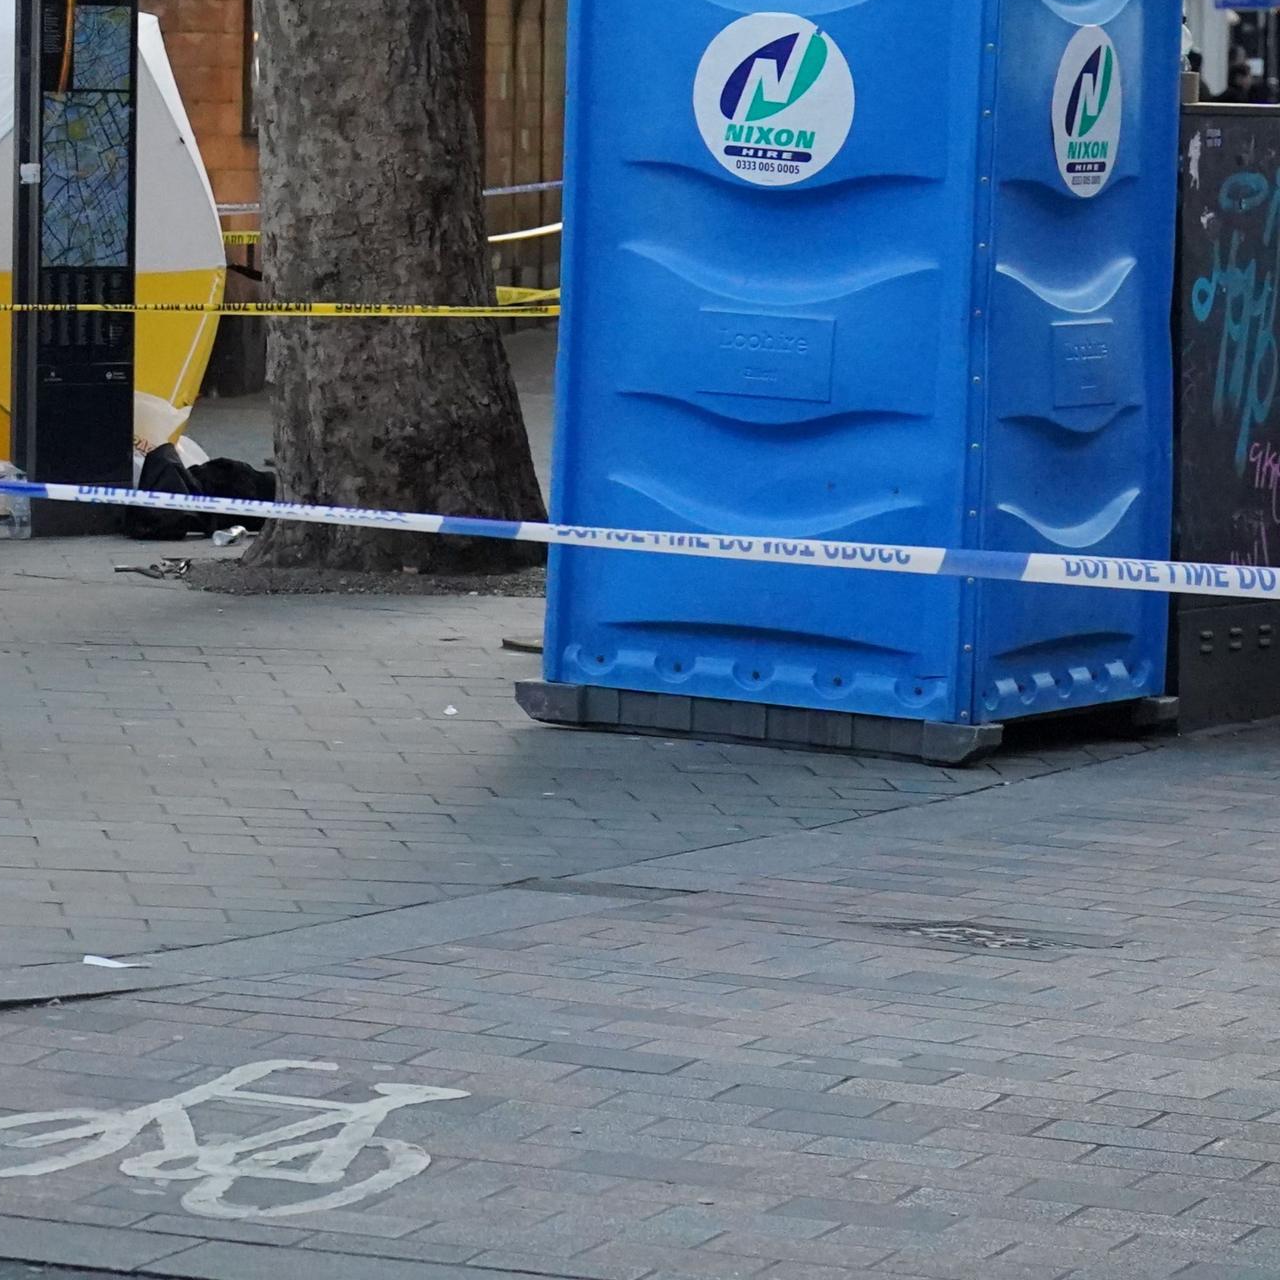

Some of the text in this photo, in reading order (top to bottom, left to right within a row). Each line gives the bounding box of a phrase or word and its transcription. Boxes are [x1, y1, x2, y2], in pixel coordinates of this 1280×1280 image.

[724, 124, 816, 149] NIXON
[742, 148, 793, 160] HIRE
[1067, 141, 1109, 160] NIXON
[736, 159, 800, 175] 0333 005 0005
[1075, 162, 1099, 172] HIRE
